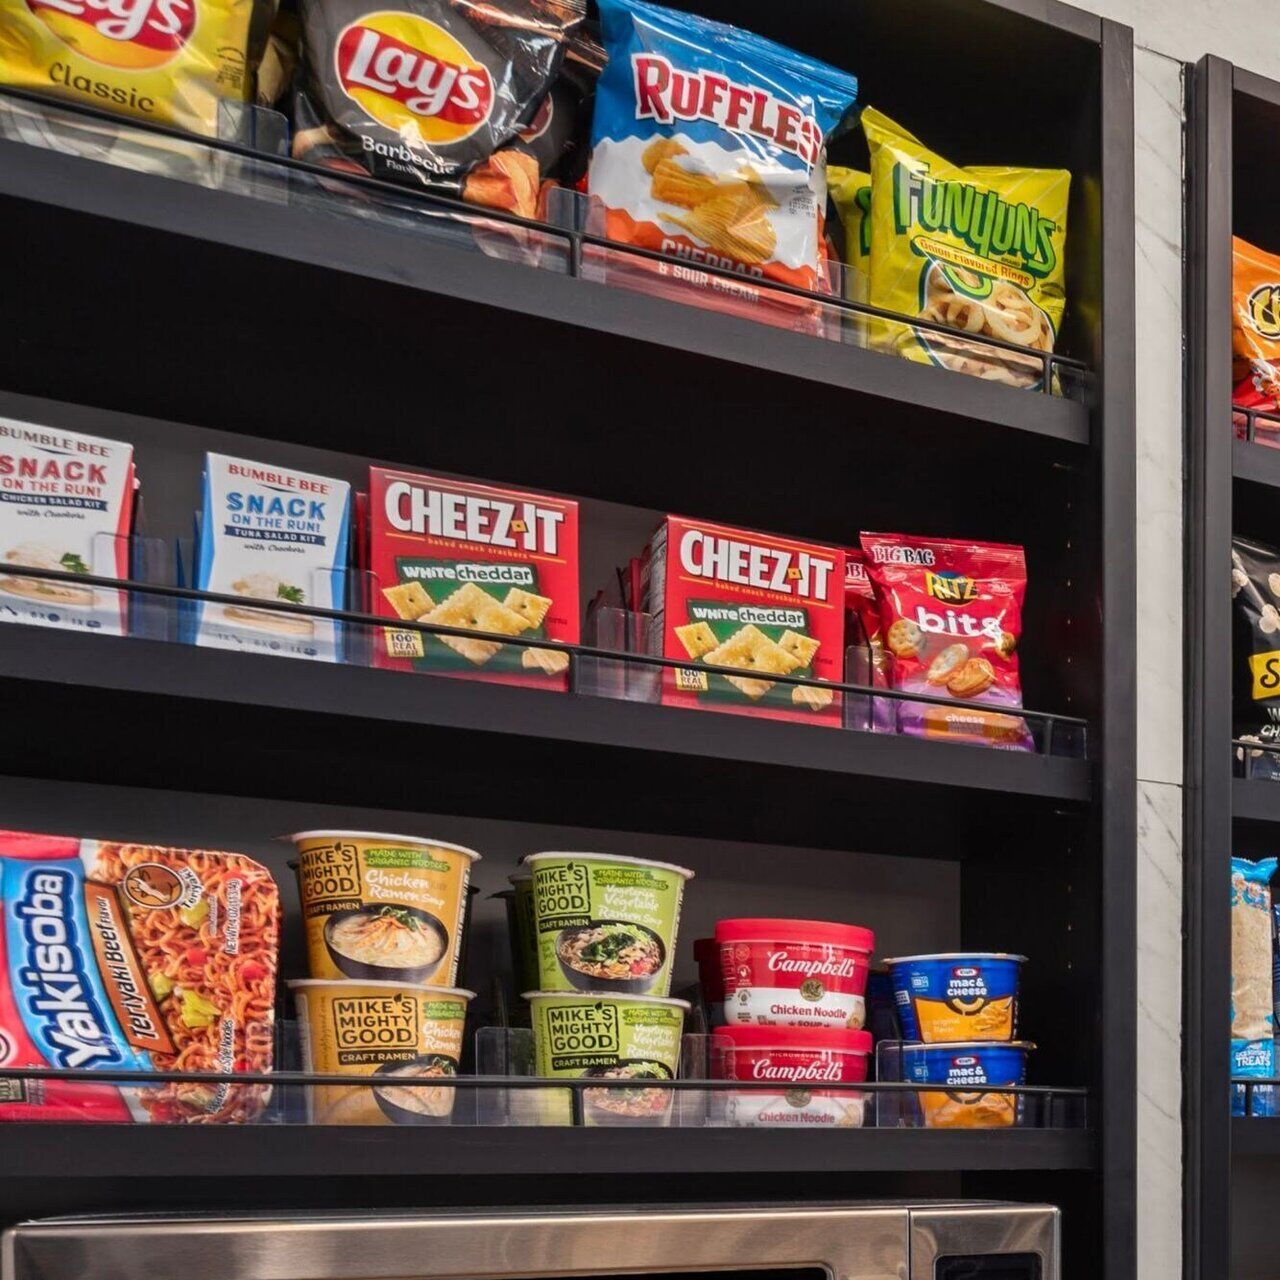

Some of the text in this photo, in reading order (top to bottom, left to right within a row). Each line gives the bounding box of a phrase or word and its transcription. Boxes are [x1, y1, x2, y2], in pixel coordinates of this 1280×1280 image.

[347, 30, 487, 117] Lay's
[49, 62, 155, 113] Classic
[635, 58, 821, 165] RUFFLES
[362, 135, 456, 176] Barbecue
[893, 160, 1056, 277] FUNYUNS
[77, 441, 109, 457] BEE
[0, 455, 107, 485] SNACK
[228, 463, 330, 495] BUMBLE BEE
[29, 481, 101, 498] THE RUN!
[85, 499, 102, 510] KIT
[226, 491, 326, 521] SNACK
[232, 513, 320, 533] ON THE RUN!
[234, 527, 316, 545] TUNA SALAD KIT
[874, 546, 935, 566] BIG BAG
[403, 565, 535, 584] WHITE cheddar
[926, 574, 977, 601] RITZ
[693, 605, 805, 628] WHITE cheddar
[916, 607, 1003, 638] bits
[305, 878, 355, 897] GOOD
[366, 869, 430, 889] Chicken
[371, 884, 420, 901] Ramen
[537, 883, 584, 899] MIGHTY
[327, 901, 360, 913] RAMEN
[539, 896, 585, 912] GOOD
[562, 918, 589, 928] RAMEN
[28, 872, 102, 1070] Yakisoba
[949, 979, 974, 988] mac
[338, 1000, 413, 1014] MIKE'S
[550, 1008, 613, 1023] MIKE'S
[770, 1004, 847, 1020] Chicken Noodle
[340, 1015, 413, 1029] MIGHTY
[552, 1022, 613, 1036] MIGHTY
[341, 1028, 413, 1045] GOOD
[553, 1035, 614, 1051] GOOD
[341, 1051, 416, 1063] CRAFT RAMEN
[553, 1056, 617, 1068] CRAFT RAMEN
[949, 1067, 974, 1077] mac
[758, 1111, 836, 1124] Chicken Noodle
